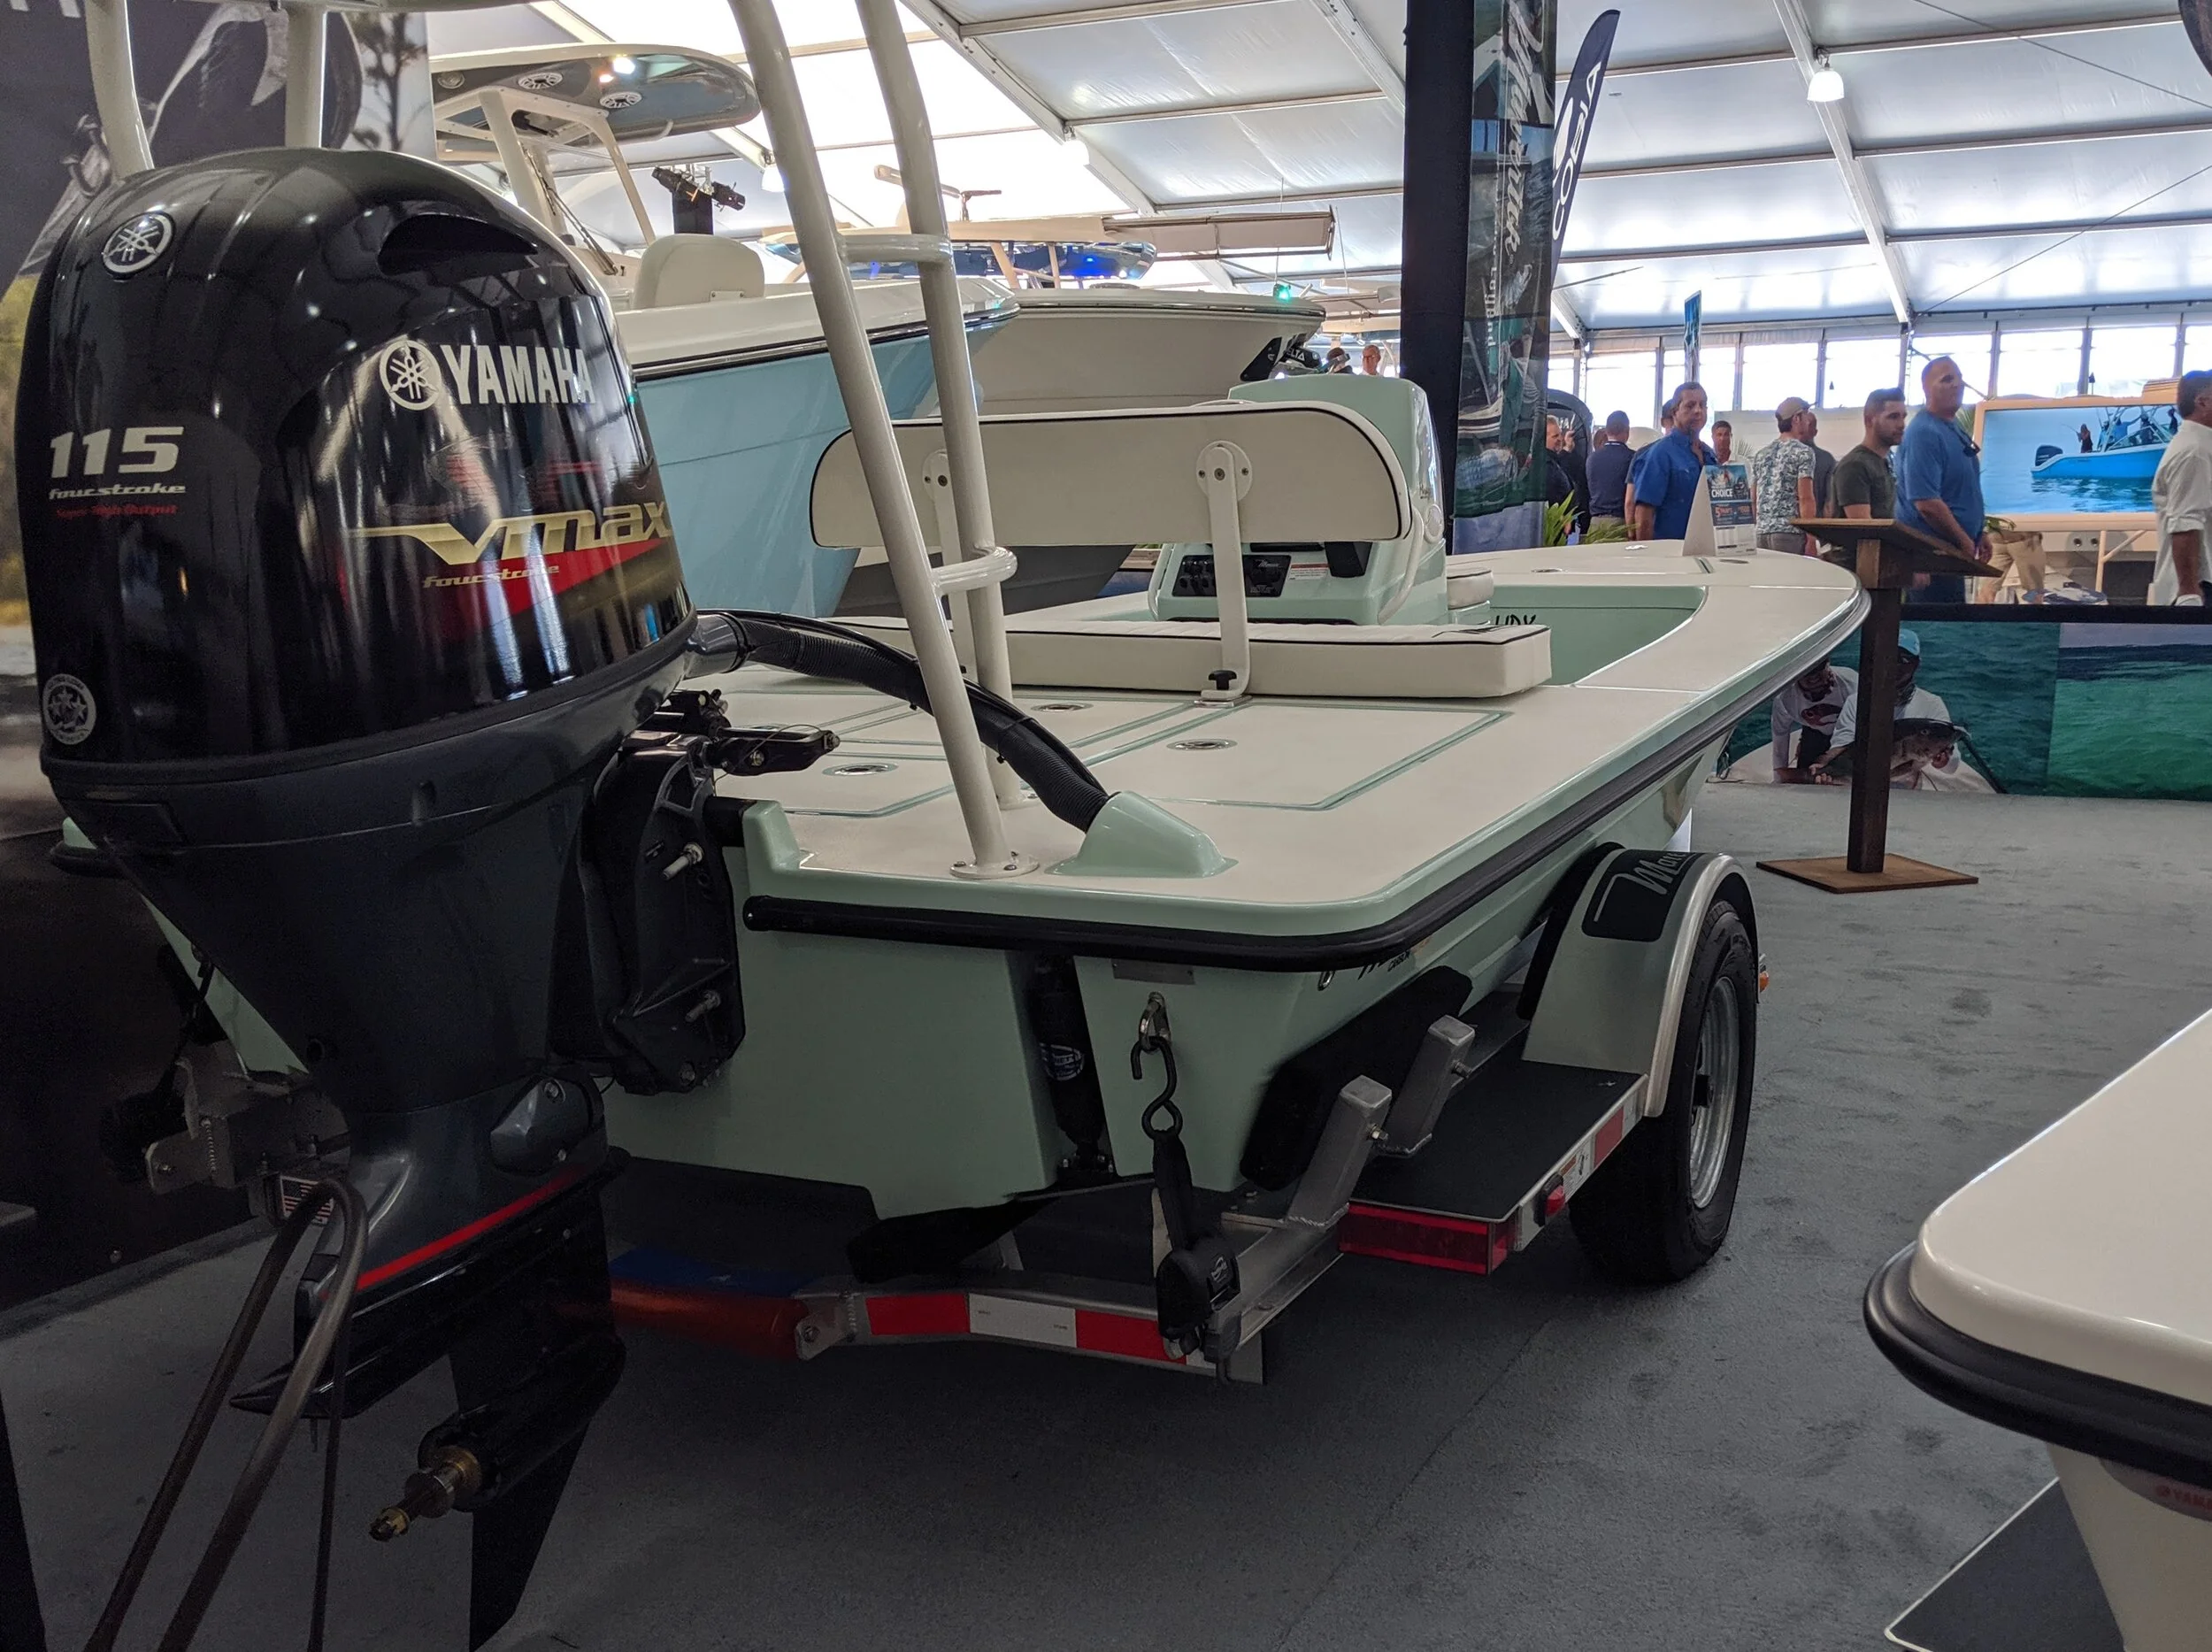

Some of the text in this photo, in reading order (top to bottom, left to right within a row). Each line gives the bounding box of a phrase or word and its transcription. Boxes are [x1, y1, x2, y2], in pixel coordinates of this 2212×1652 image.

[1552, 61, 1601, 242] COBIA
[1286, 347, 1306, 362] ELTA
[440, 343, 597, 405] YAMAHA
[50, 426, 184, 479] 115
[49, 483, 187, 500] fourstroke
[1711, 488, 1733, 498] CHOICE
[423, 565, 559, 588] fourstroe
